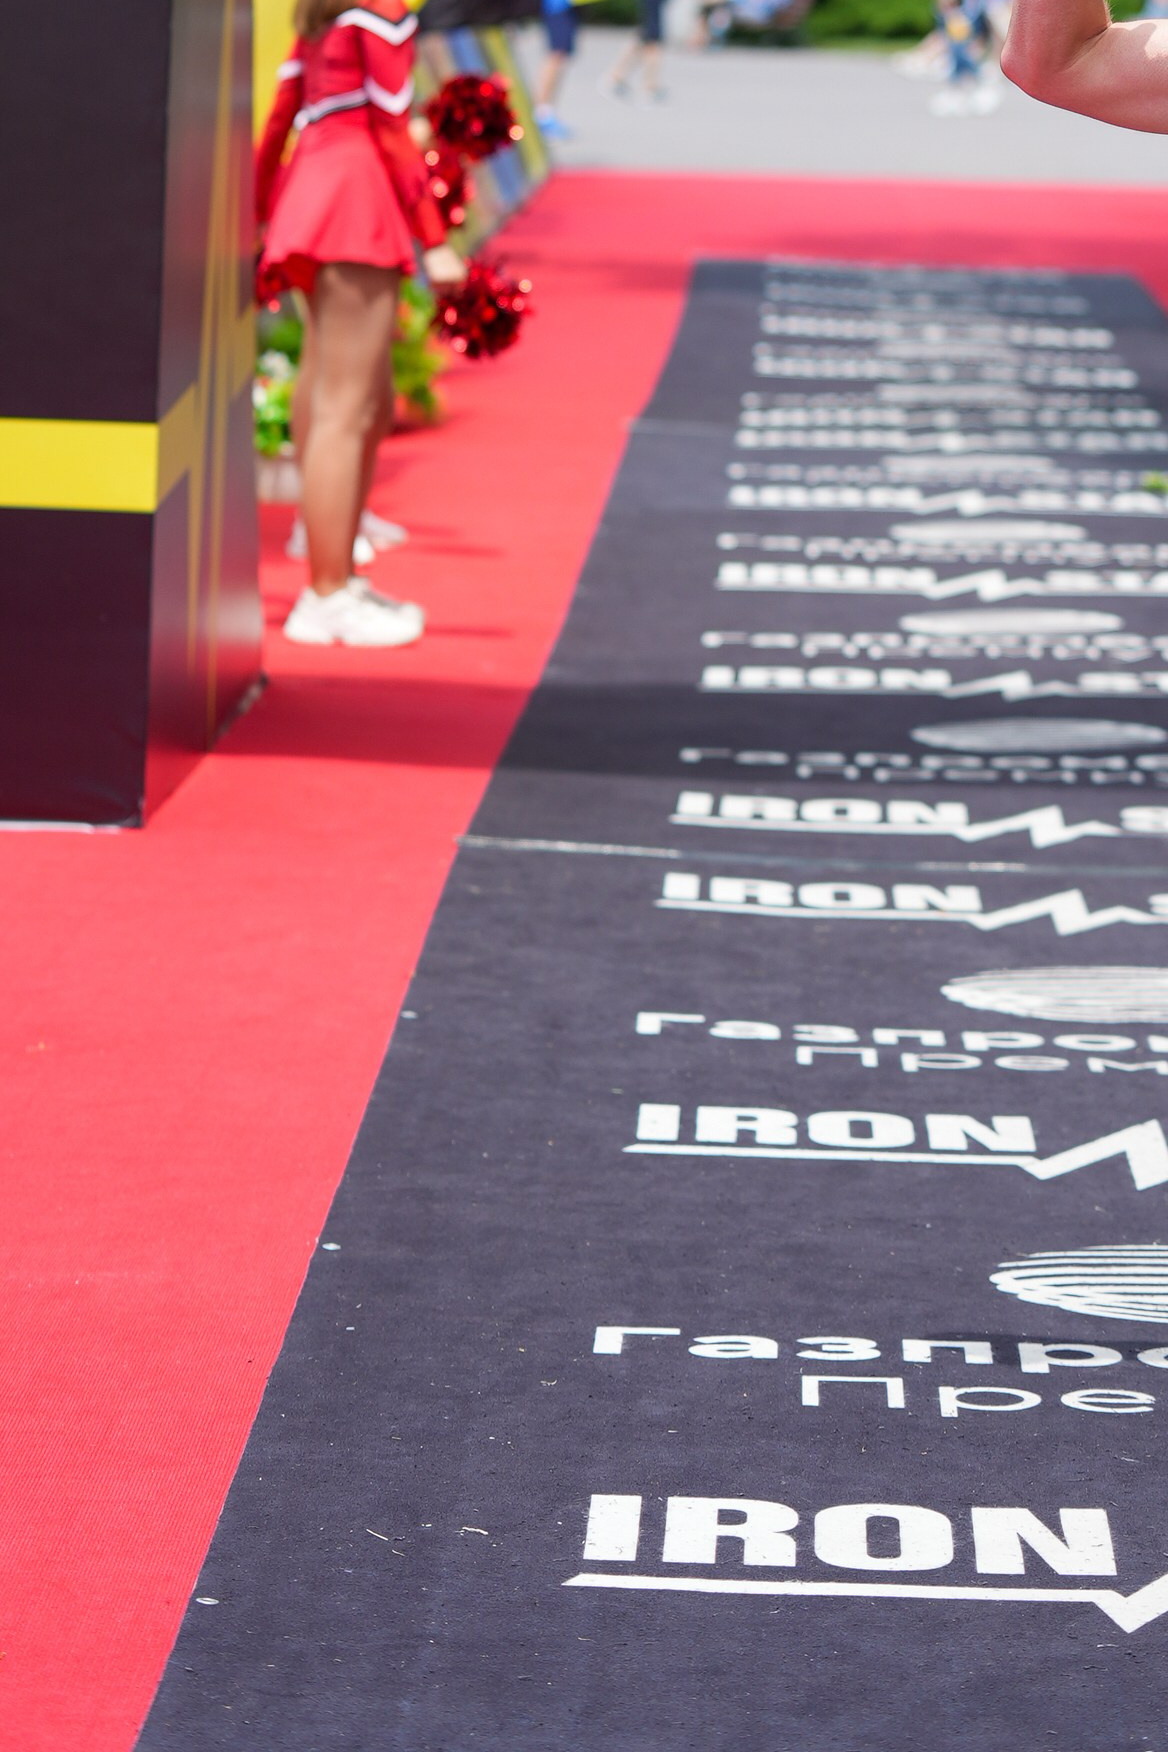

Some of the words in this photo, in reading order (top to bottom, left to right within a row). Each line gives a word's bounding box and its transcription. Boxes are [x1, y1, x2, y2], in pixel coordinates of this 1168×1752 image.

[676, 791, 969, 828] IRON
[662, 872, 983, 913] IRON
[636, 1104, 1037, 1154] IRON
[584, 1493, 1117, 1578] IRON
